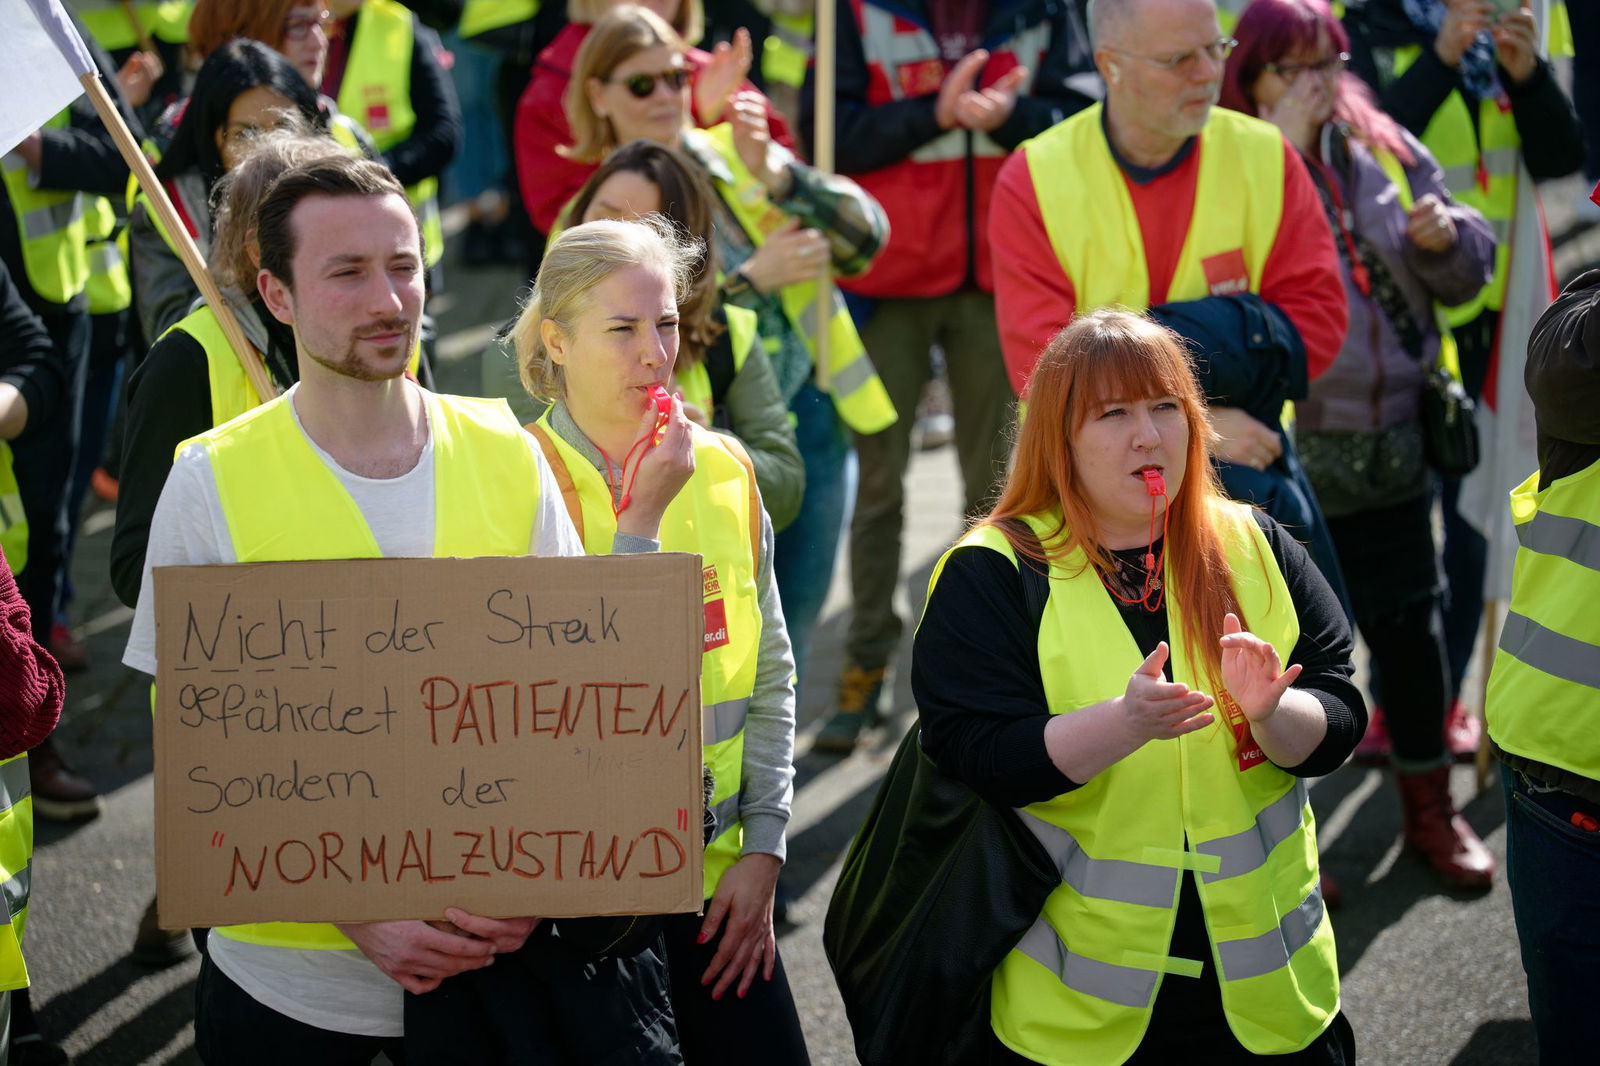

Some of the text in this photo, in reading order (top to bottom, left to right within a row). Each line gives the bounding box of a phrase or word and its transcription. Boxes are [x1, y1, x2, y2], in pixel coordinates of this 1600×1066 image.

[183, 588, 621, 664] Nicht der Streik
[704, 628, 725, 642] er.di
[178, 675, 690, 751] gefährdet PATIENTEN,
[442, 767, 519, 809] der
[211, 808, 689, 897] "NORMALZUSTAND"
